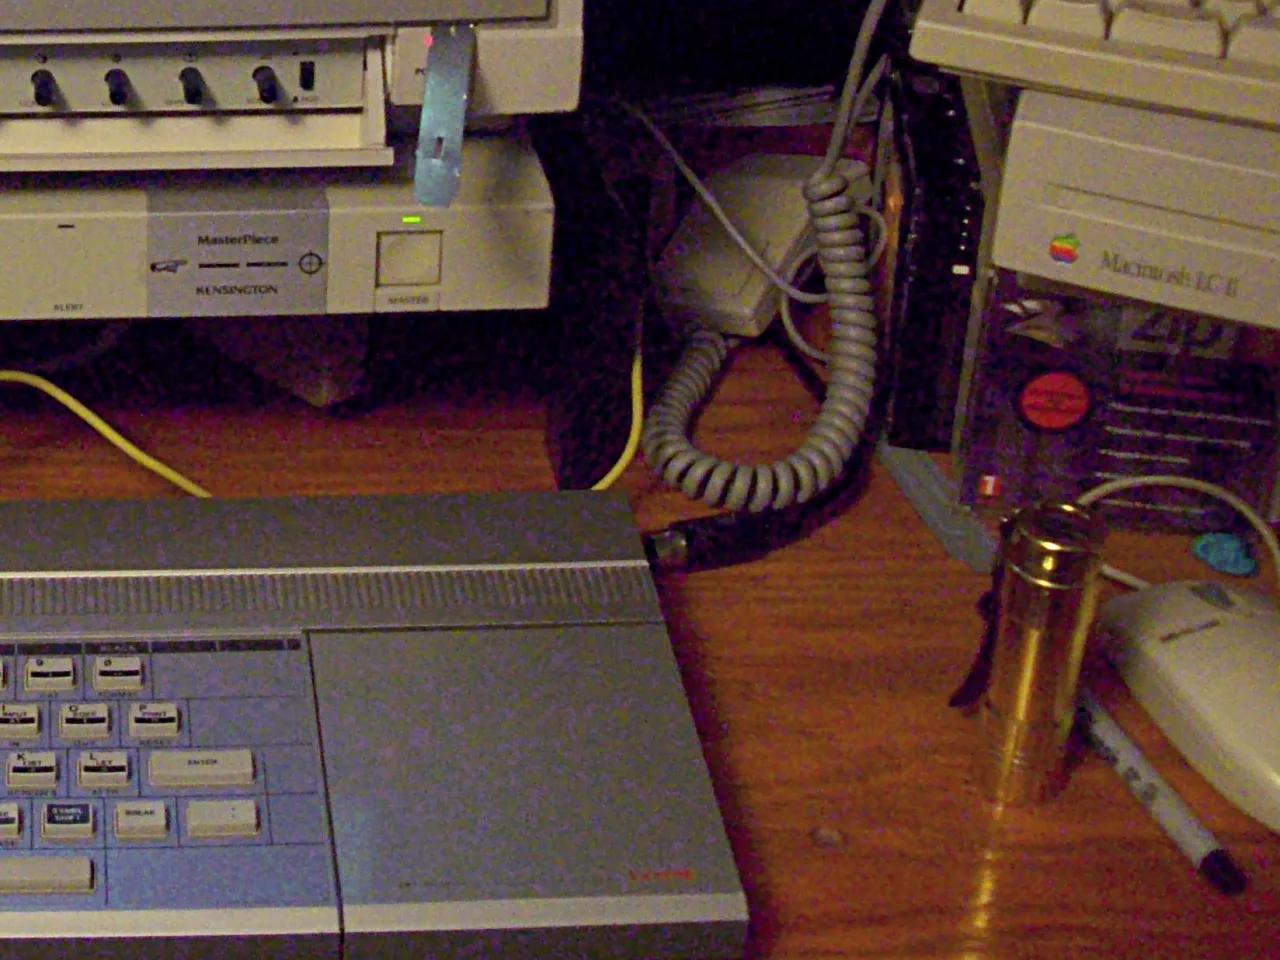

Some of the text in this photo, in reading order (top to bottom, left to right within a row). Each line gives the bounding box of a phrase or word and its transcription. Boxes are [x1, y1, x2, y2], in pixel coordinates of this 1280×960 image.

[197, 235, 279, 245] MasterPiece
[195, 285, 278, 295] KENSINGTON
[387, 296, 429, 305] MASTER
